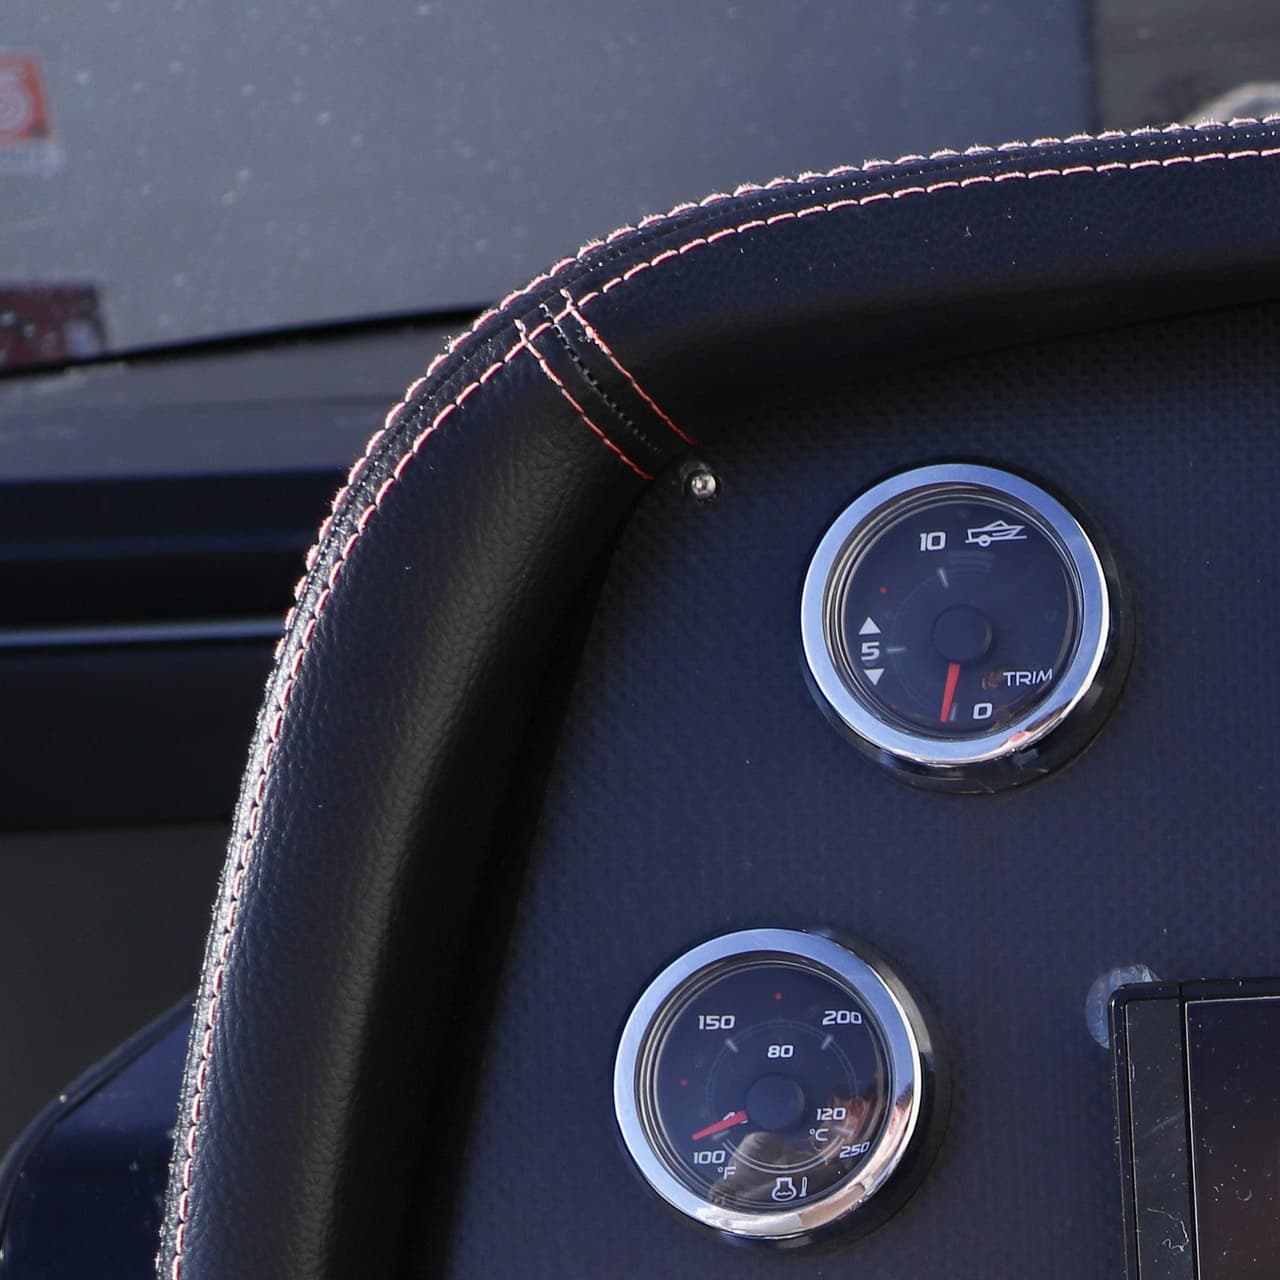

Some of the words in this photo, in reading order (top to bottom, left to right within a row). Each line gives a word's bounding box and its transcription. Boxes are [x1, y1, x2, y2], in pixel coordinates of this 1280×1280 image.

[920, 532, 946, 551] 10
[861, 641, 880, 660] 5
[1003, 668, 1053, 687] TRIM
[972, 702, 992, 721] 0
[698, 1015, 736, 1030] 150
[822, 1010, 862, 1025] 200
[767, 1045, 794, 1058] 80
[816, 1107, 847, 1121] 120
[693, 1150, 726, 1164] 100
[839, 1142, 870, 1159] 250
